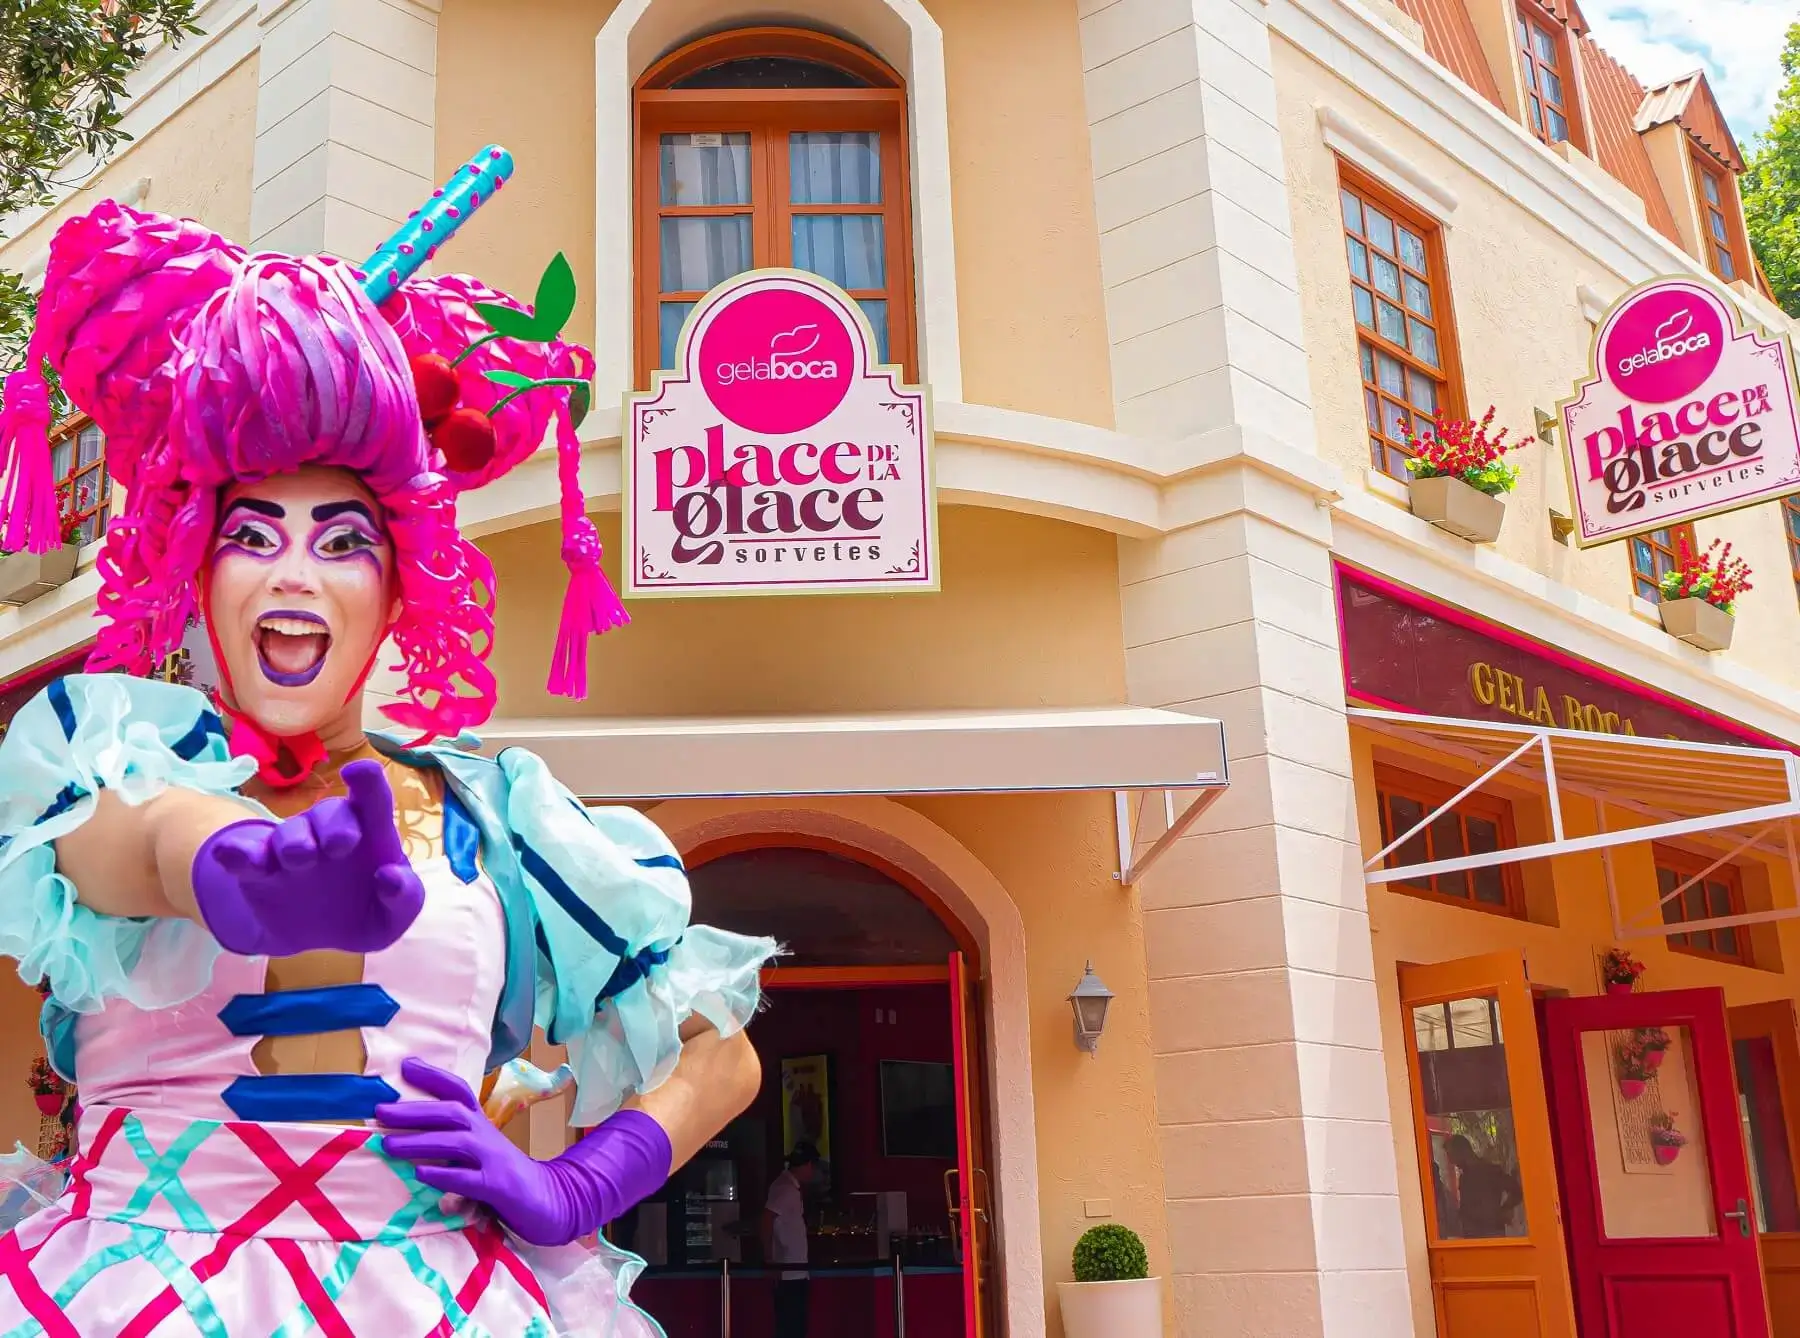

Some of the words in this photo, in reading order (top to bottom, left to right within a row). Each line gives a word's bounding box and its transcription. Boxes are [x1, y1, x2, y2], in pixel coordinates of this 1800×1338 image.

[716, 355, 838, 385] gelaboca
[1618, 332, 1710, 376] gelaboca
[1744, 400, 1772, 418] LA
[1583, 391, 1740, 482] place
[1742, 384, 1769, 404] DE
[652, 424, 861, 512] place
[867, 444, 899, 462] DE
[868, 464, 901, 481] LA
[1603, 421, 1763, 514] glace
[1654, 463, 1765, 503] sorvetes
[671, 481, 884, 565] glace
[736, 542, 881, 563] sorvetes
[1469, 662, 1557, 727] GELA
